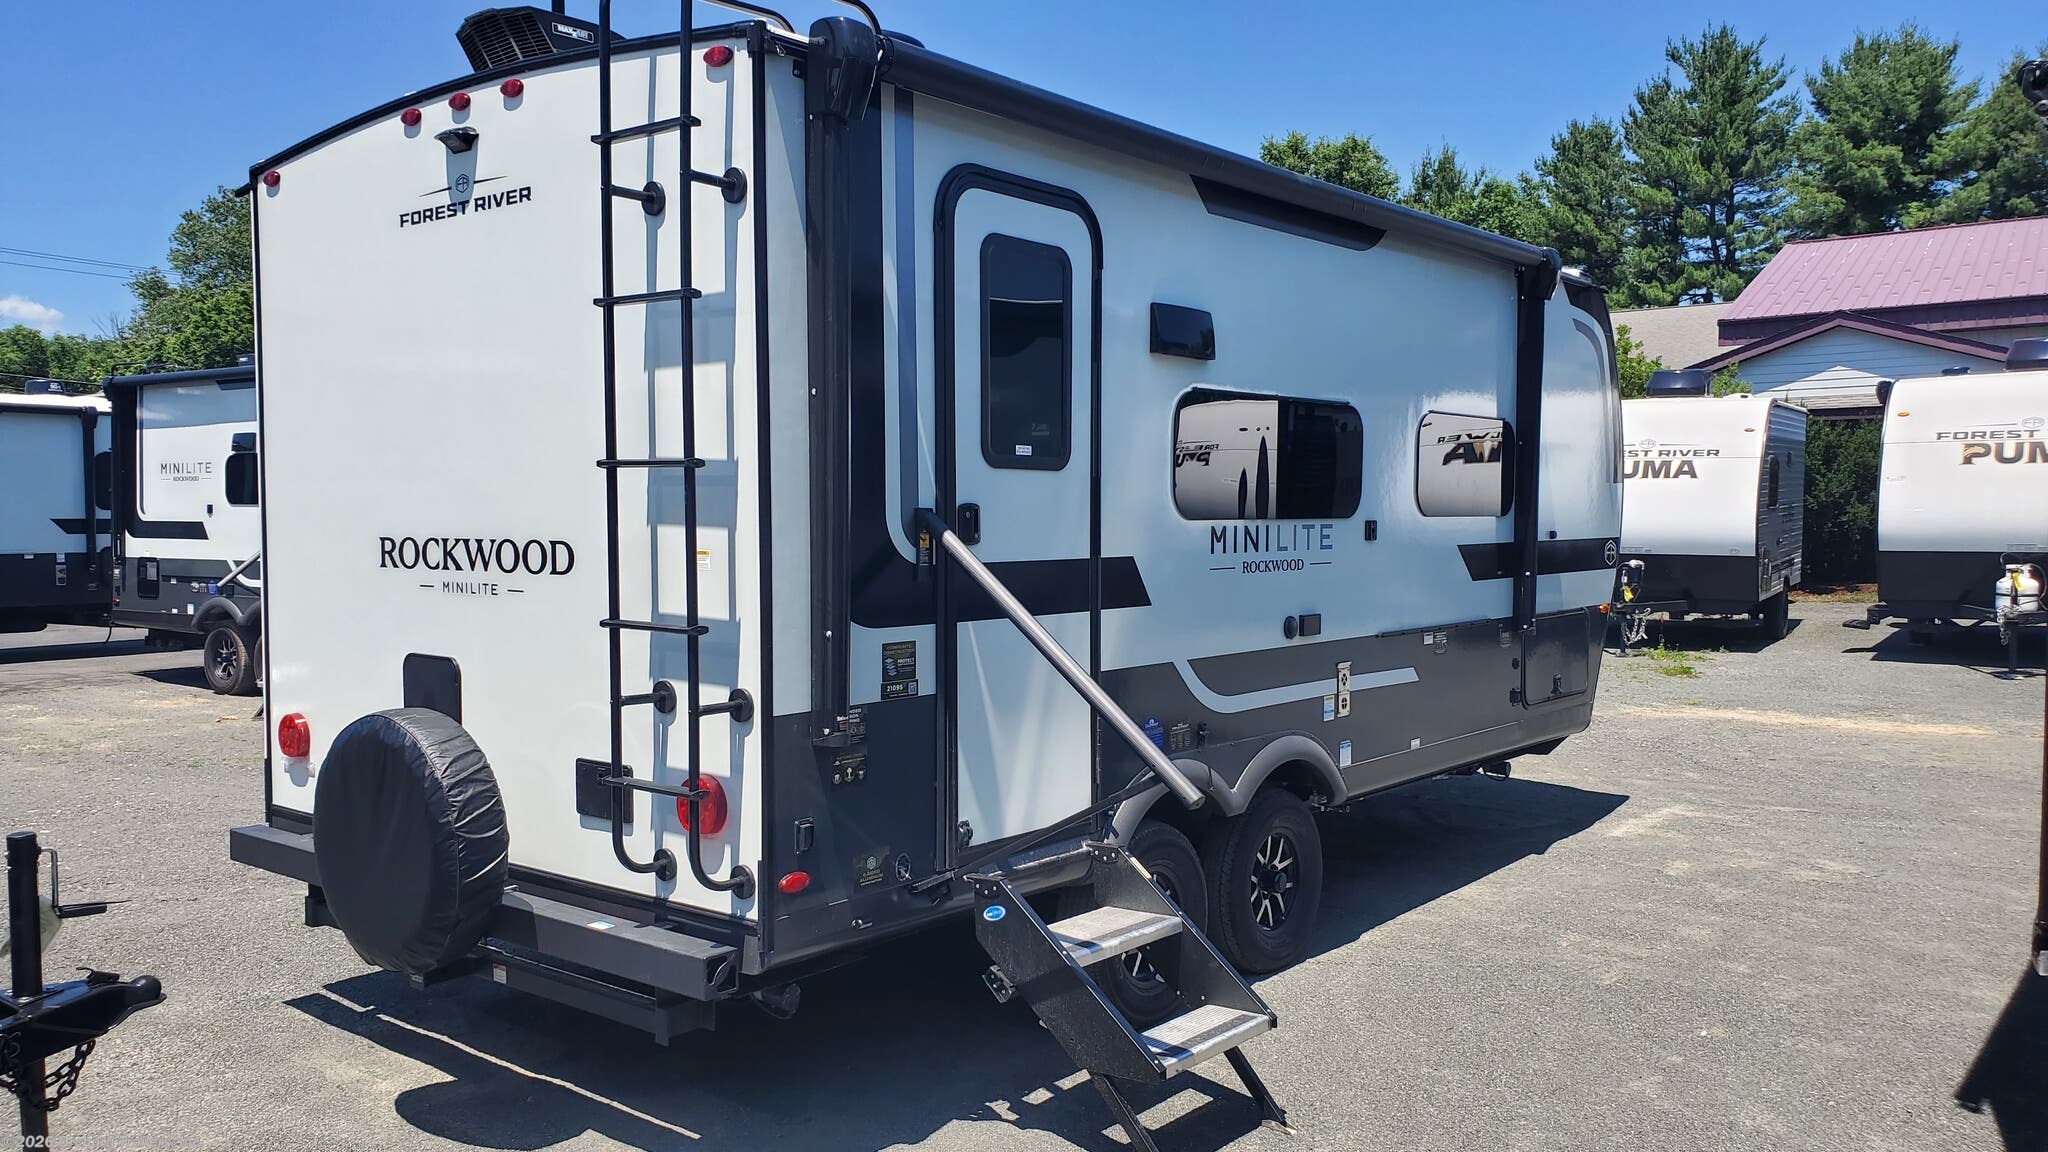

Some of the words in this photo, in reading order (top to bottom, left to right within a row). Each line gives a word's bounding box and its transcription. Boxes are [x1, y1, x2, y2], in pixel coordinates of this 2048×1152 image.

[399, 200, 470, 228] FOREST
[473, 186, 532, 213] RIVER
[1936, 429, 2041, 441] FOREST
[1624, 449, 1652, 458] ST
[1658, 449, 1720, 457] RIVER
[160, 462, 212, 474] MINILITE
[1210, 523, 1333, 555] MINILITE
[379, 536, 575, 576] ROCKWOOD
[1242, 559, 1304, 574] ROCKWOOD
[442, 581, 499, 596] MINILITE
